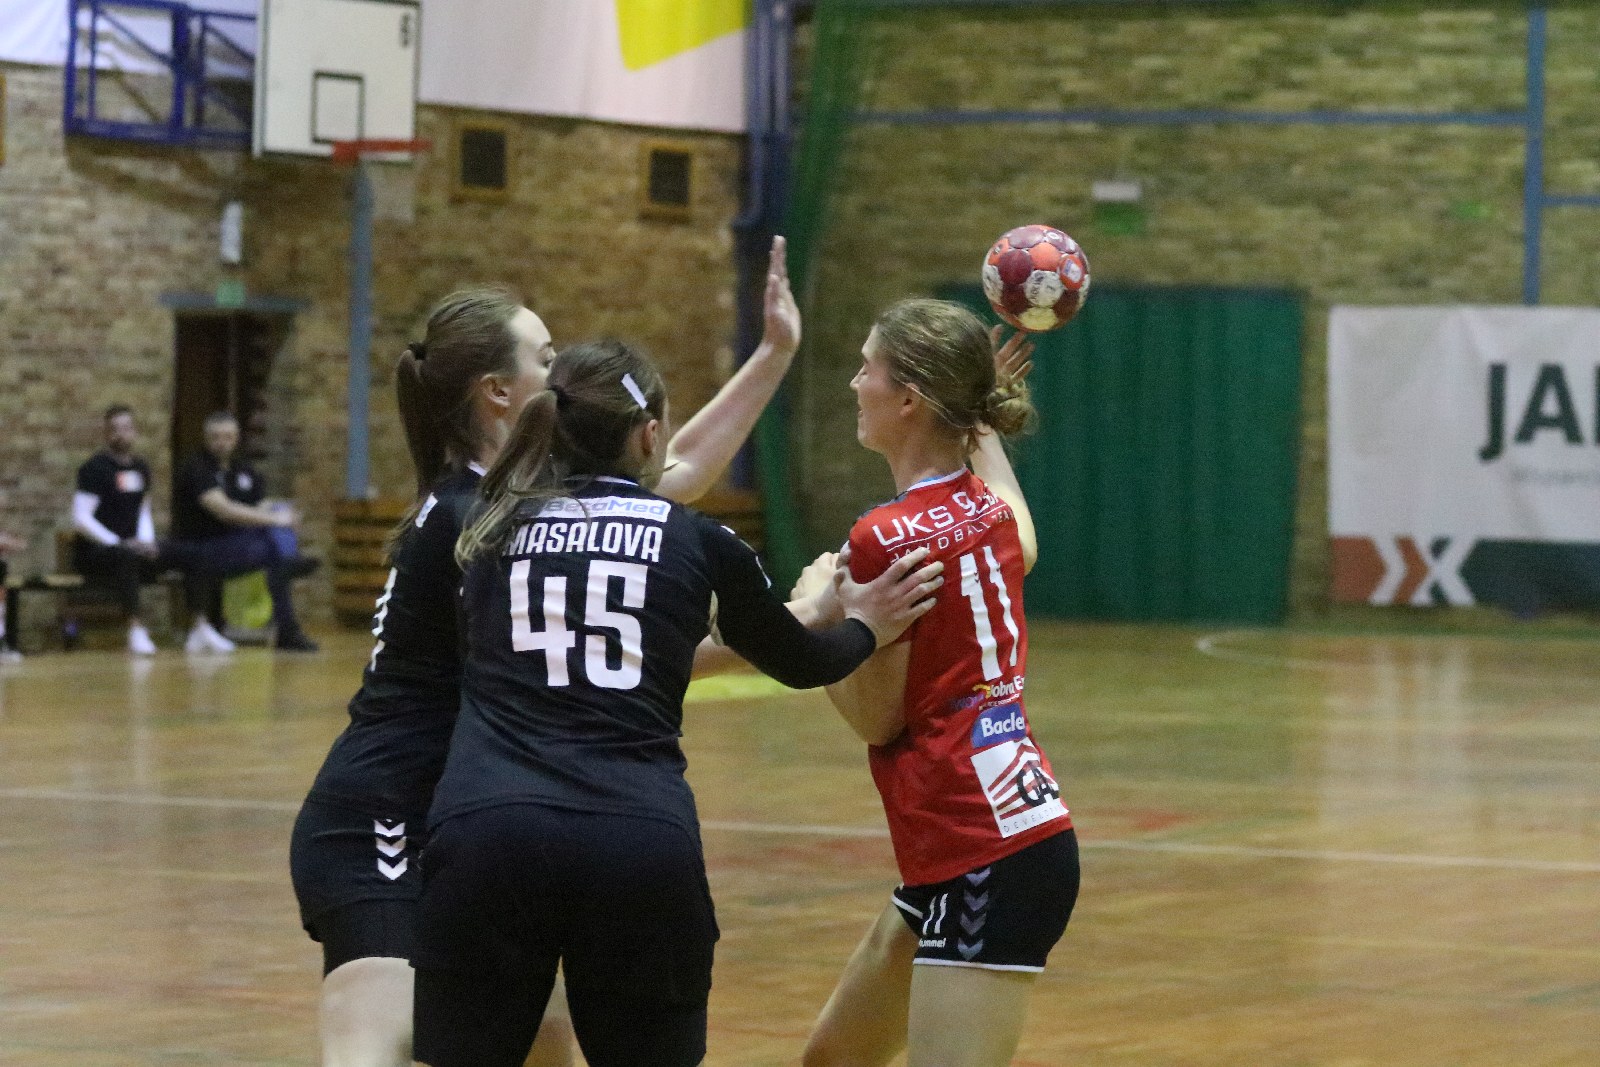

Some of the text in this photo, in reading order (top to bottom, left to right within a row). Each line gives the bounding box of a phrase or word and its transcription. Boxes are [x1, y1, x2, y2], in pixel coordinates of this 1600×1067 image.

[1479, 361, 1600, 463] JA
[544, 499, 667, 516] BetaMed
[872, 505, 954, 546] UKS
[504, 521, 664, 563] MASALOVA
[509, 559, 649, 690] 45
[960, 545, 1019, 681] 11
[922, 893, 949, 936] 11
